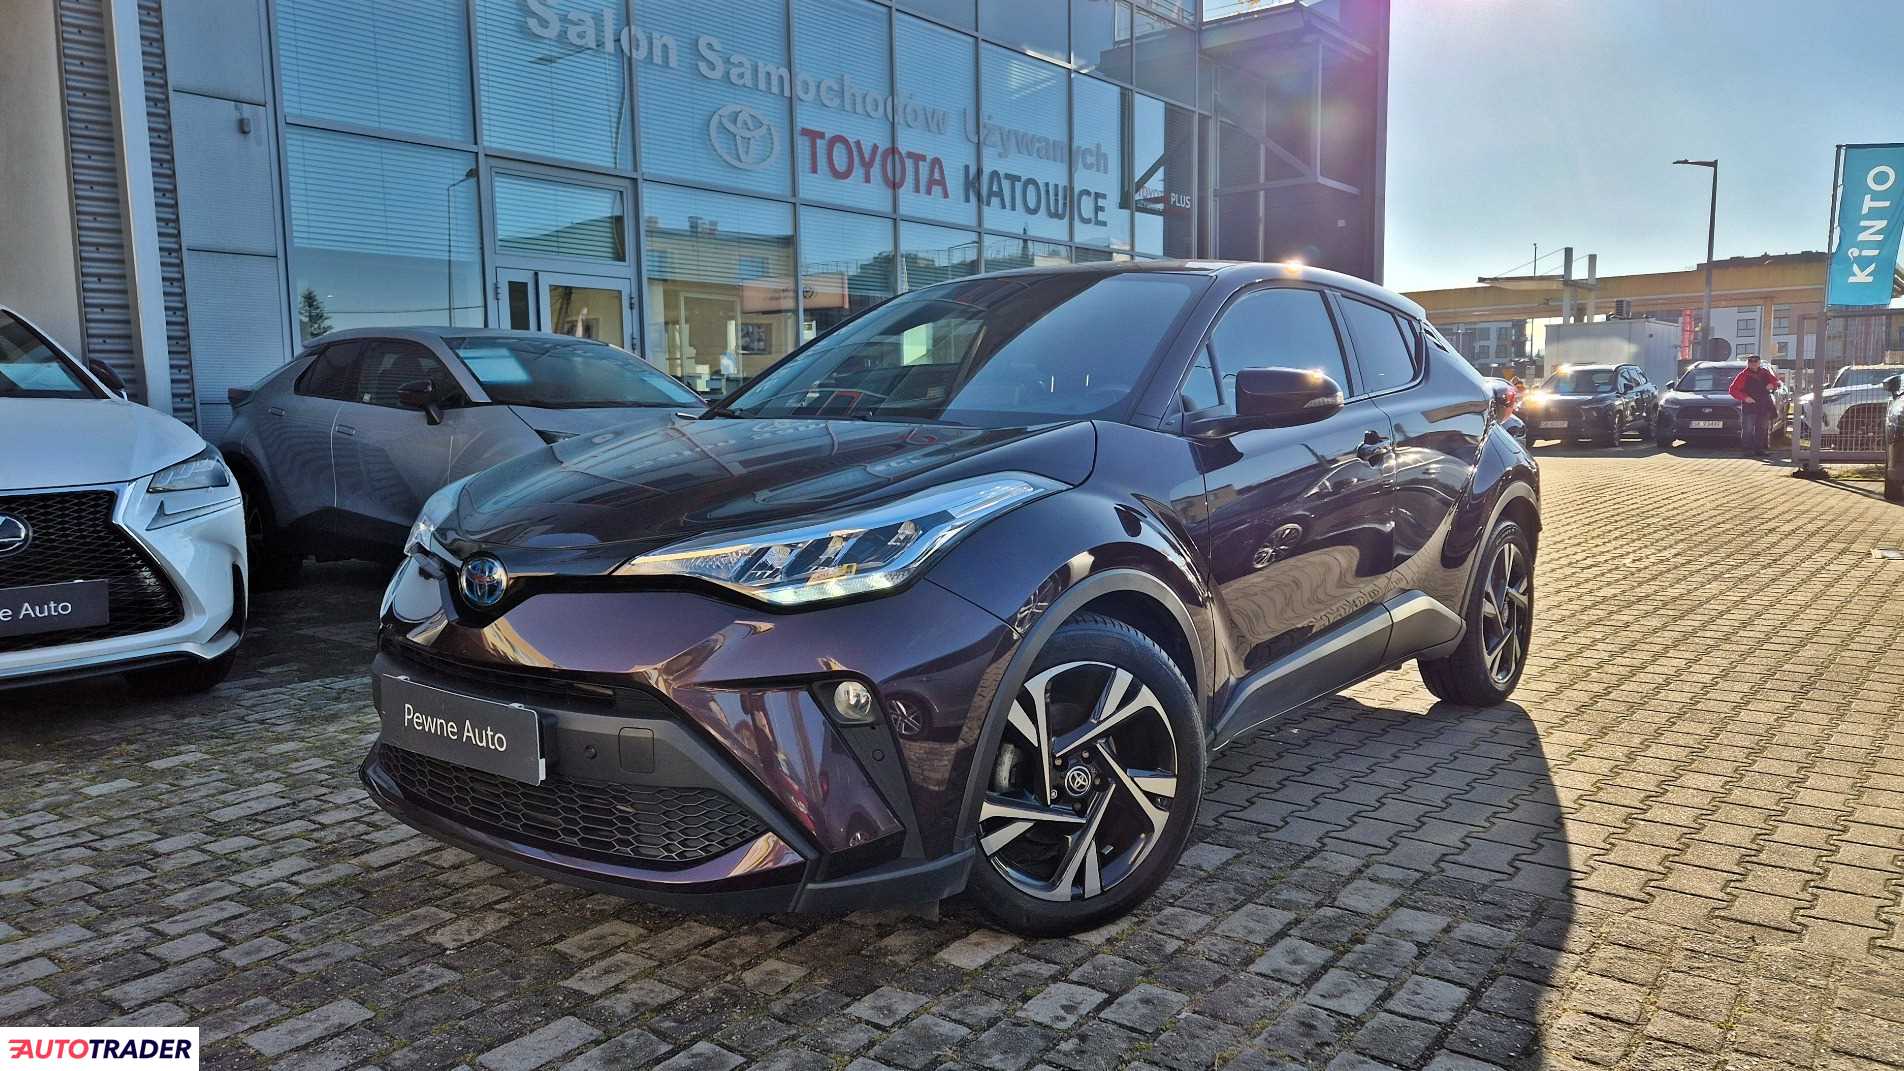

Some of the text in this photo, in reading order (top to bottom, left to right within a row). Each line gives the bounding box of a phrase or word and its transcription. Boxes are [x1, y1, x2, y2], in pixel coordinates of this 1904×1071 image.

[526, 0, 678, 67] Salon
[697, 35, 946, 135] Samochodów
[800, 127, 1108, 227] TOYOTA KATOWICE
[1170, 192, 1191, 208] PLUS
[19, 601, 72, 619] Auto
[404, 703, 507, 751] Pewne Auto
